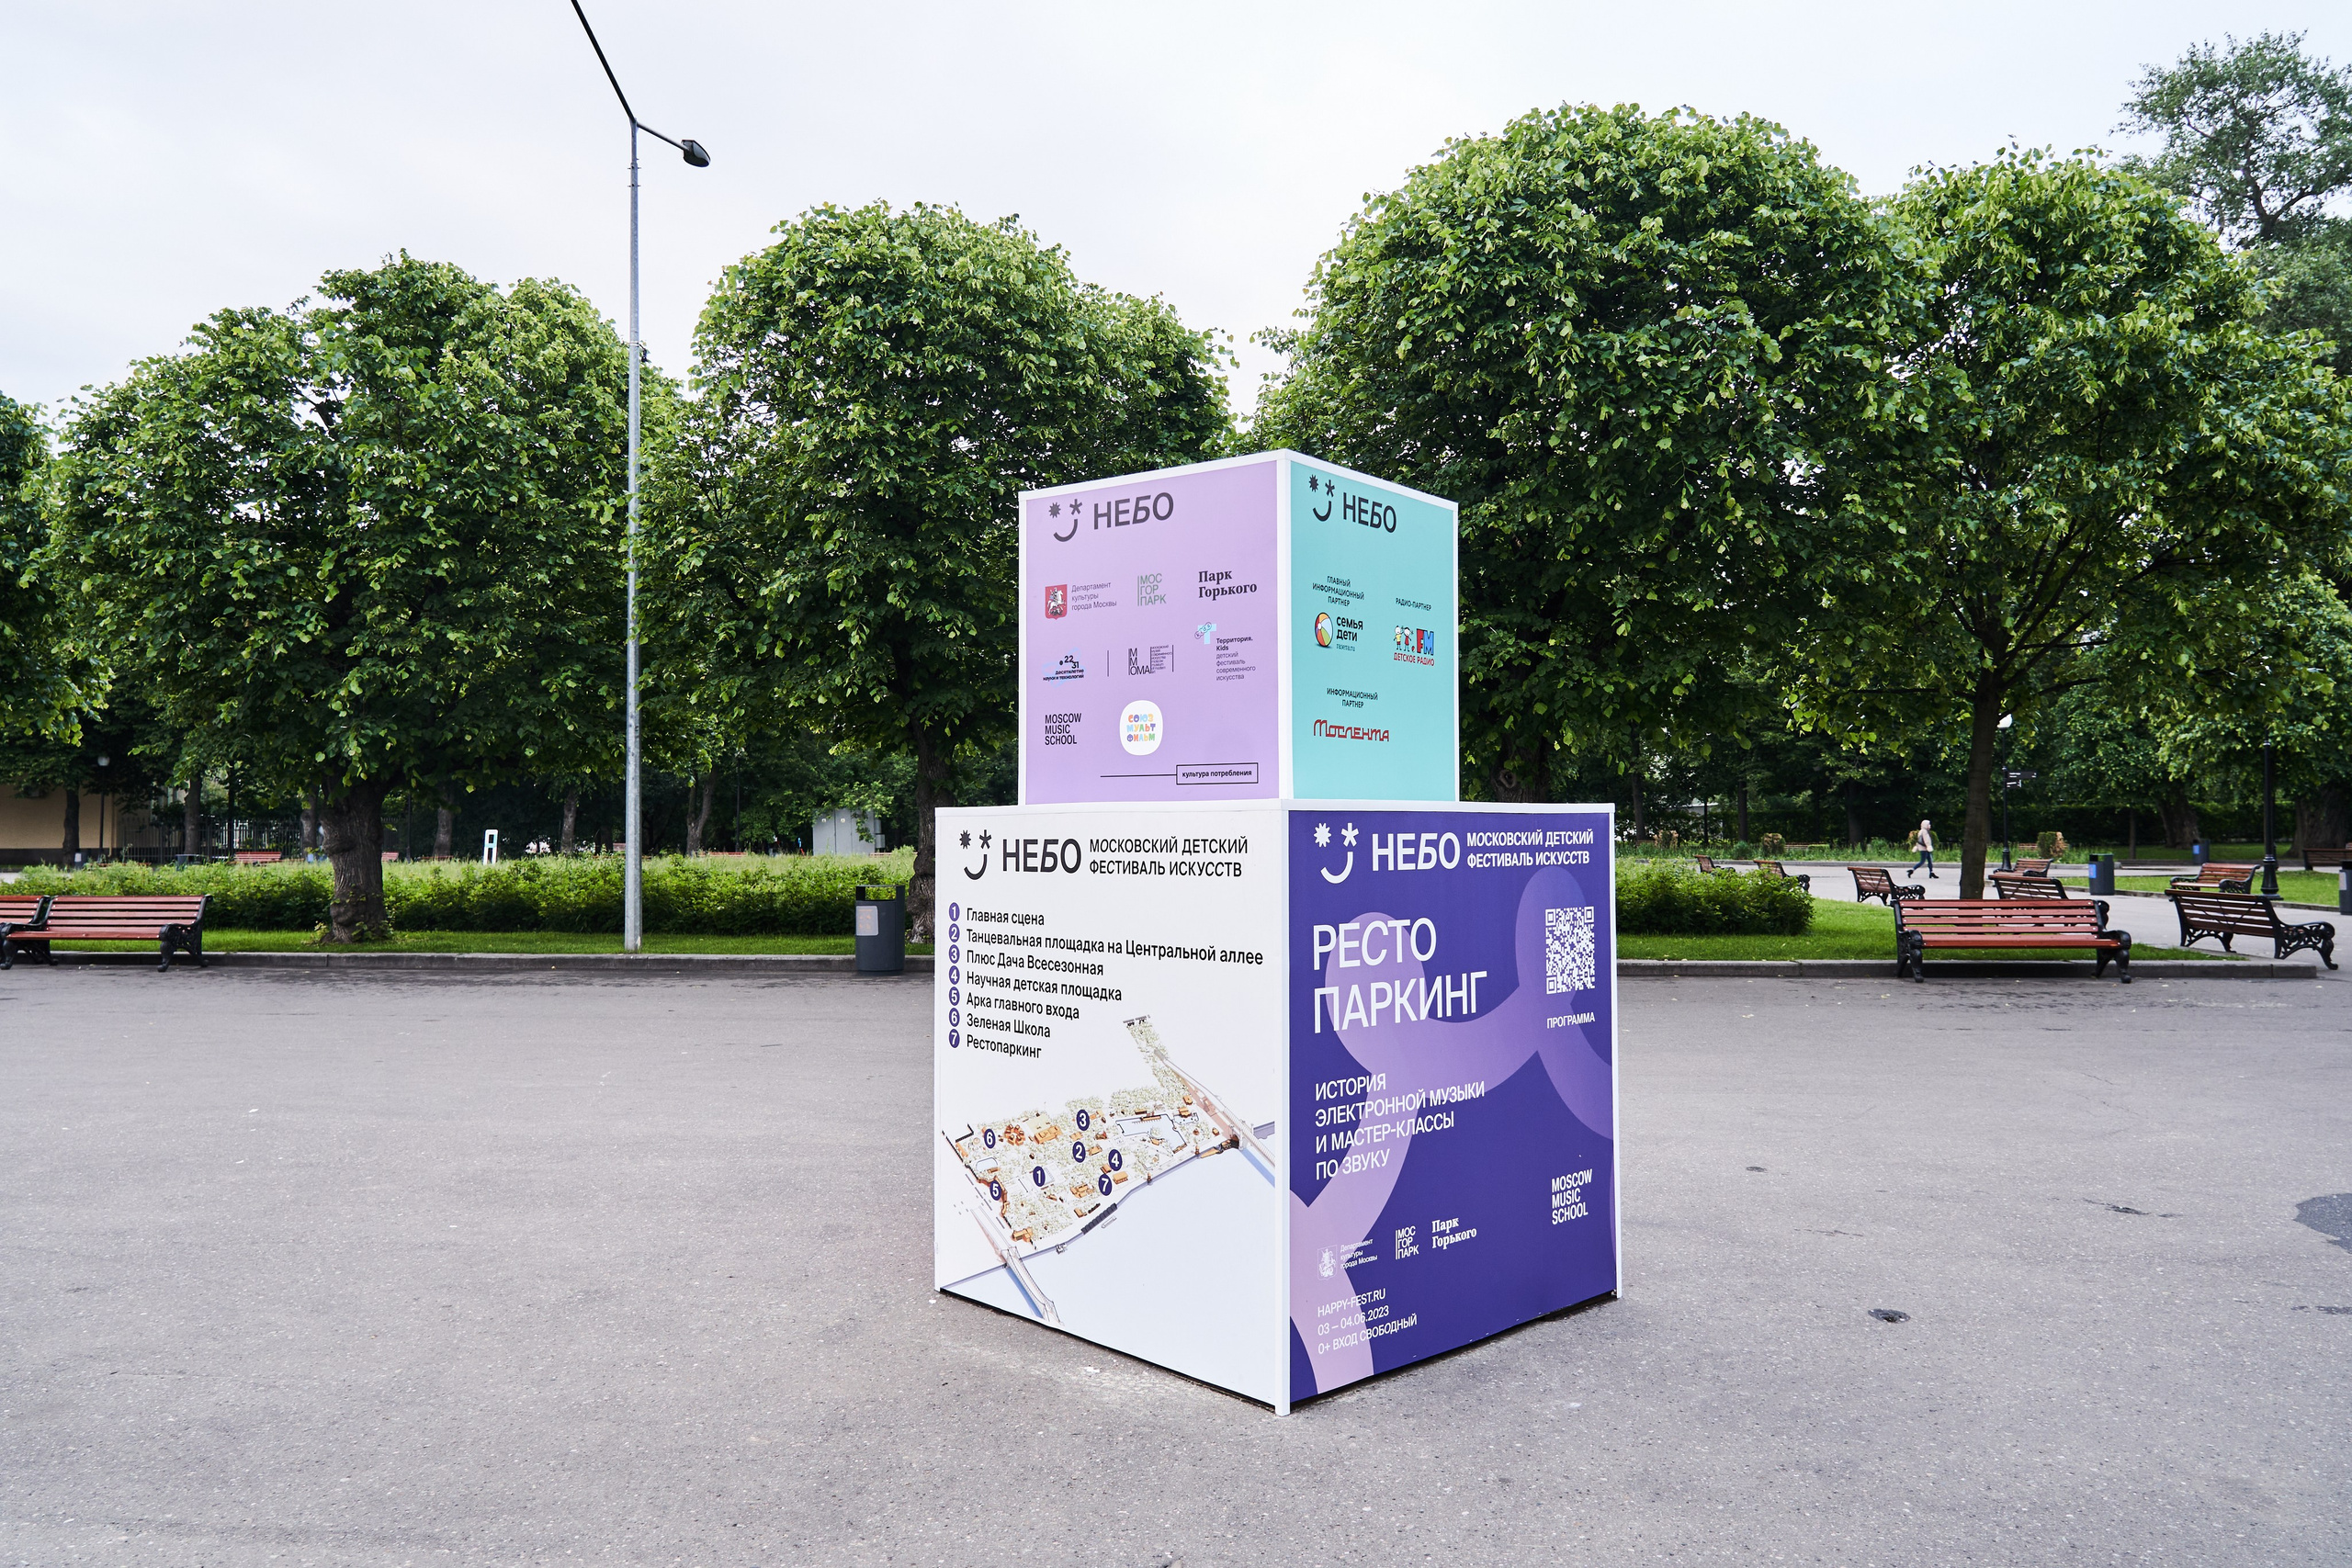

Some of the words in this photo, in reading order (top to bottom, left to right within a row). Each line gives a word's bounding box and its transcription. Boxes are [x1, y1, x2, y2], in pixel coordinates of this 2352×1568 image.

[1094, 492, 1173, 530] НЕБО
[1343, 492, 1396, 533] НЕБО
[1140, 573, 1162, 585] МОС
[1199, 570, 1232, 584] Парк
[1327, 575, 1351, 587] ГЛАВНЫЙ
[1072, 582, 1111, 592] Департамент
[1140, 585, 1159, 595] ГОР
[1199, 583, 1257, 601] Горького
[1312, 583, 1365, 600] ИНФОРМАЦИОННЫЙ
[1072, 593, 1099, 602] культуры
[1072, 603, 1092, 611] города
[1093, 601, 1117, 609] Москвы
[1140, 594, 1166, 606] ПАРК
[1328, 596, 1350, 607] ПАРТНЕР
[1396, 598, 1432, 611] РАДИО-ПАРТНЕР
[1336, 616, 1363, 630] семья
[1336, 629, 1357, 642] дети
[1394, 652, 1416, 664] ДЕТСКОЕ
[1417, 655, 1435, 666] РАДИО
[1327, 688, 1378, 700] ИНФОРМАЦИОННЫЙ
[1342, 699, 1364, 708] ПАРТНЕР
[1045, 713, 1082, 724] MOSCOW
[1128, 713, 1154, 723] СОЮЗ
[1045, 724, 1070, 734] MUSIC
[1126, 723, 1156, 732] МУЛЬТ
[1045, 735, 1077, 745] SCHOOL
[1127, 733, 1155, 742] ФИЛЬМ
[1210, 769, 1252, 777] потребления
[1090, 836, 1178, 853] МОСКОВСКИЙ
[1182, 836, 1248, 856] ДЕТСКИЙ
[1467, 829, 1543, 847] МОСКОВСКИЙ
[1545, 829, 1594, 847] ДЕТСКИЙ
[1003, 839, 1082, 874] НЕБО
[1372, 832, 1461, 872] НЕБО
[1467, 852, 1533, 868] ФЕСТИВАЛЬ
[1536, 851, 1589, 866] ИСКУССТВ
[1089, 859, 1165, 875] ФЕСТИВАЛЬ
[1170, 862, 1242, 877] ИСКУССТВ
[967, 908, 1009, 923] Главная
[1011, 913, 1044, 926] сцена
[967, 928, 1042, 948] Танцевальная
[1045, 937, 1104, 953] площадка
[1108, 941, 1122, 954] на
[1125, 939, 1216, 962] Центральной
[1220, 949, 1263, 965] аллее
[1313, 917, 1437, 971] РЕСТО
[967, 950, 995, 965] Плюс
[997, 952, 1024, 968] Дача
[1027, 955, 1104, 976] Всесезонная
[967, 971, 1011, 989] Научная
[1013, 978, 1057, 994] детская
[1061, 983, 1122, 1002] площадка
[967, 992, 992, 1009] Арка
[994, 998, 1043, 1015] главного
[1046, 1004, 1079, 1020] входа
[1314, 971, 1487, 1034] ПАРКИНГ
[967, 1013, 1010, 1032] Зеленая
[1014, 1019, 1050, 1038] Школа
[1546, 1012, 1595, 1029] ПРОГРАММА
[967, 1034, 1041, 1058] Рестопаркинг
[1315, 1073, 1386, 1101] ИСТОРИЯ
[1315, 1089, 1426, 1127] ЭЛЕКТРОННОЙ
[1430, 1081, 1485, 1107] МУЗЫКИ
[1316, 1135, 1327, 1154] И
[1332, 1111, 1454, 1151] МАСТЕР-КЛАССЫ
[1316, 1159, 1338, 1180] ПО
[1342, 1149, 1390, 1175] ЗВУКУ
[1551, 1169, 1592, 1193] MOSCOW
[1552, 1187, 1581, 1209] MUSIC
[1552, 1202, 1588, 1225] SCHOOL
[1398, 1226, 1416, 1239] МОС
[1432, 1217, 1459, 1233] Парк
[1398, 1238, 1413, 1249] ГОР
[1432, 1228, 1477, 1250] Горького
[1398, 1245, 1419, 1259] ПАРК
[1317, 1288, 1386, 1318] HAPPY-FEST.RU
[1318, 1323, 1330, 1336] 03
[1340, 1305, 1389, 1329] 04.06.2023
[1318, 1342, 1331, 1354] 0+
[1333, 1333, 1357, 1350] ВХОД
[1360, 1313, 1417, 1341] СВОБОДНЫЙ
